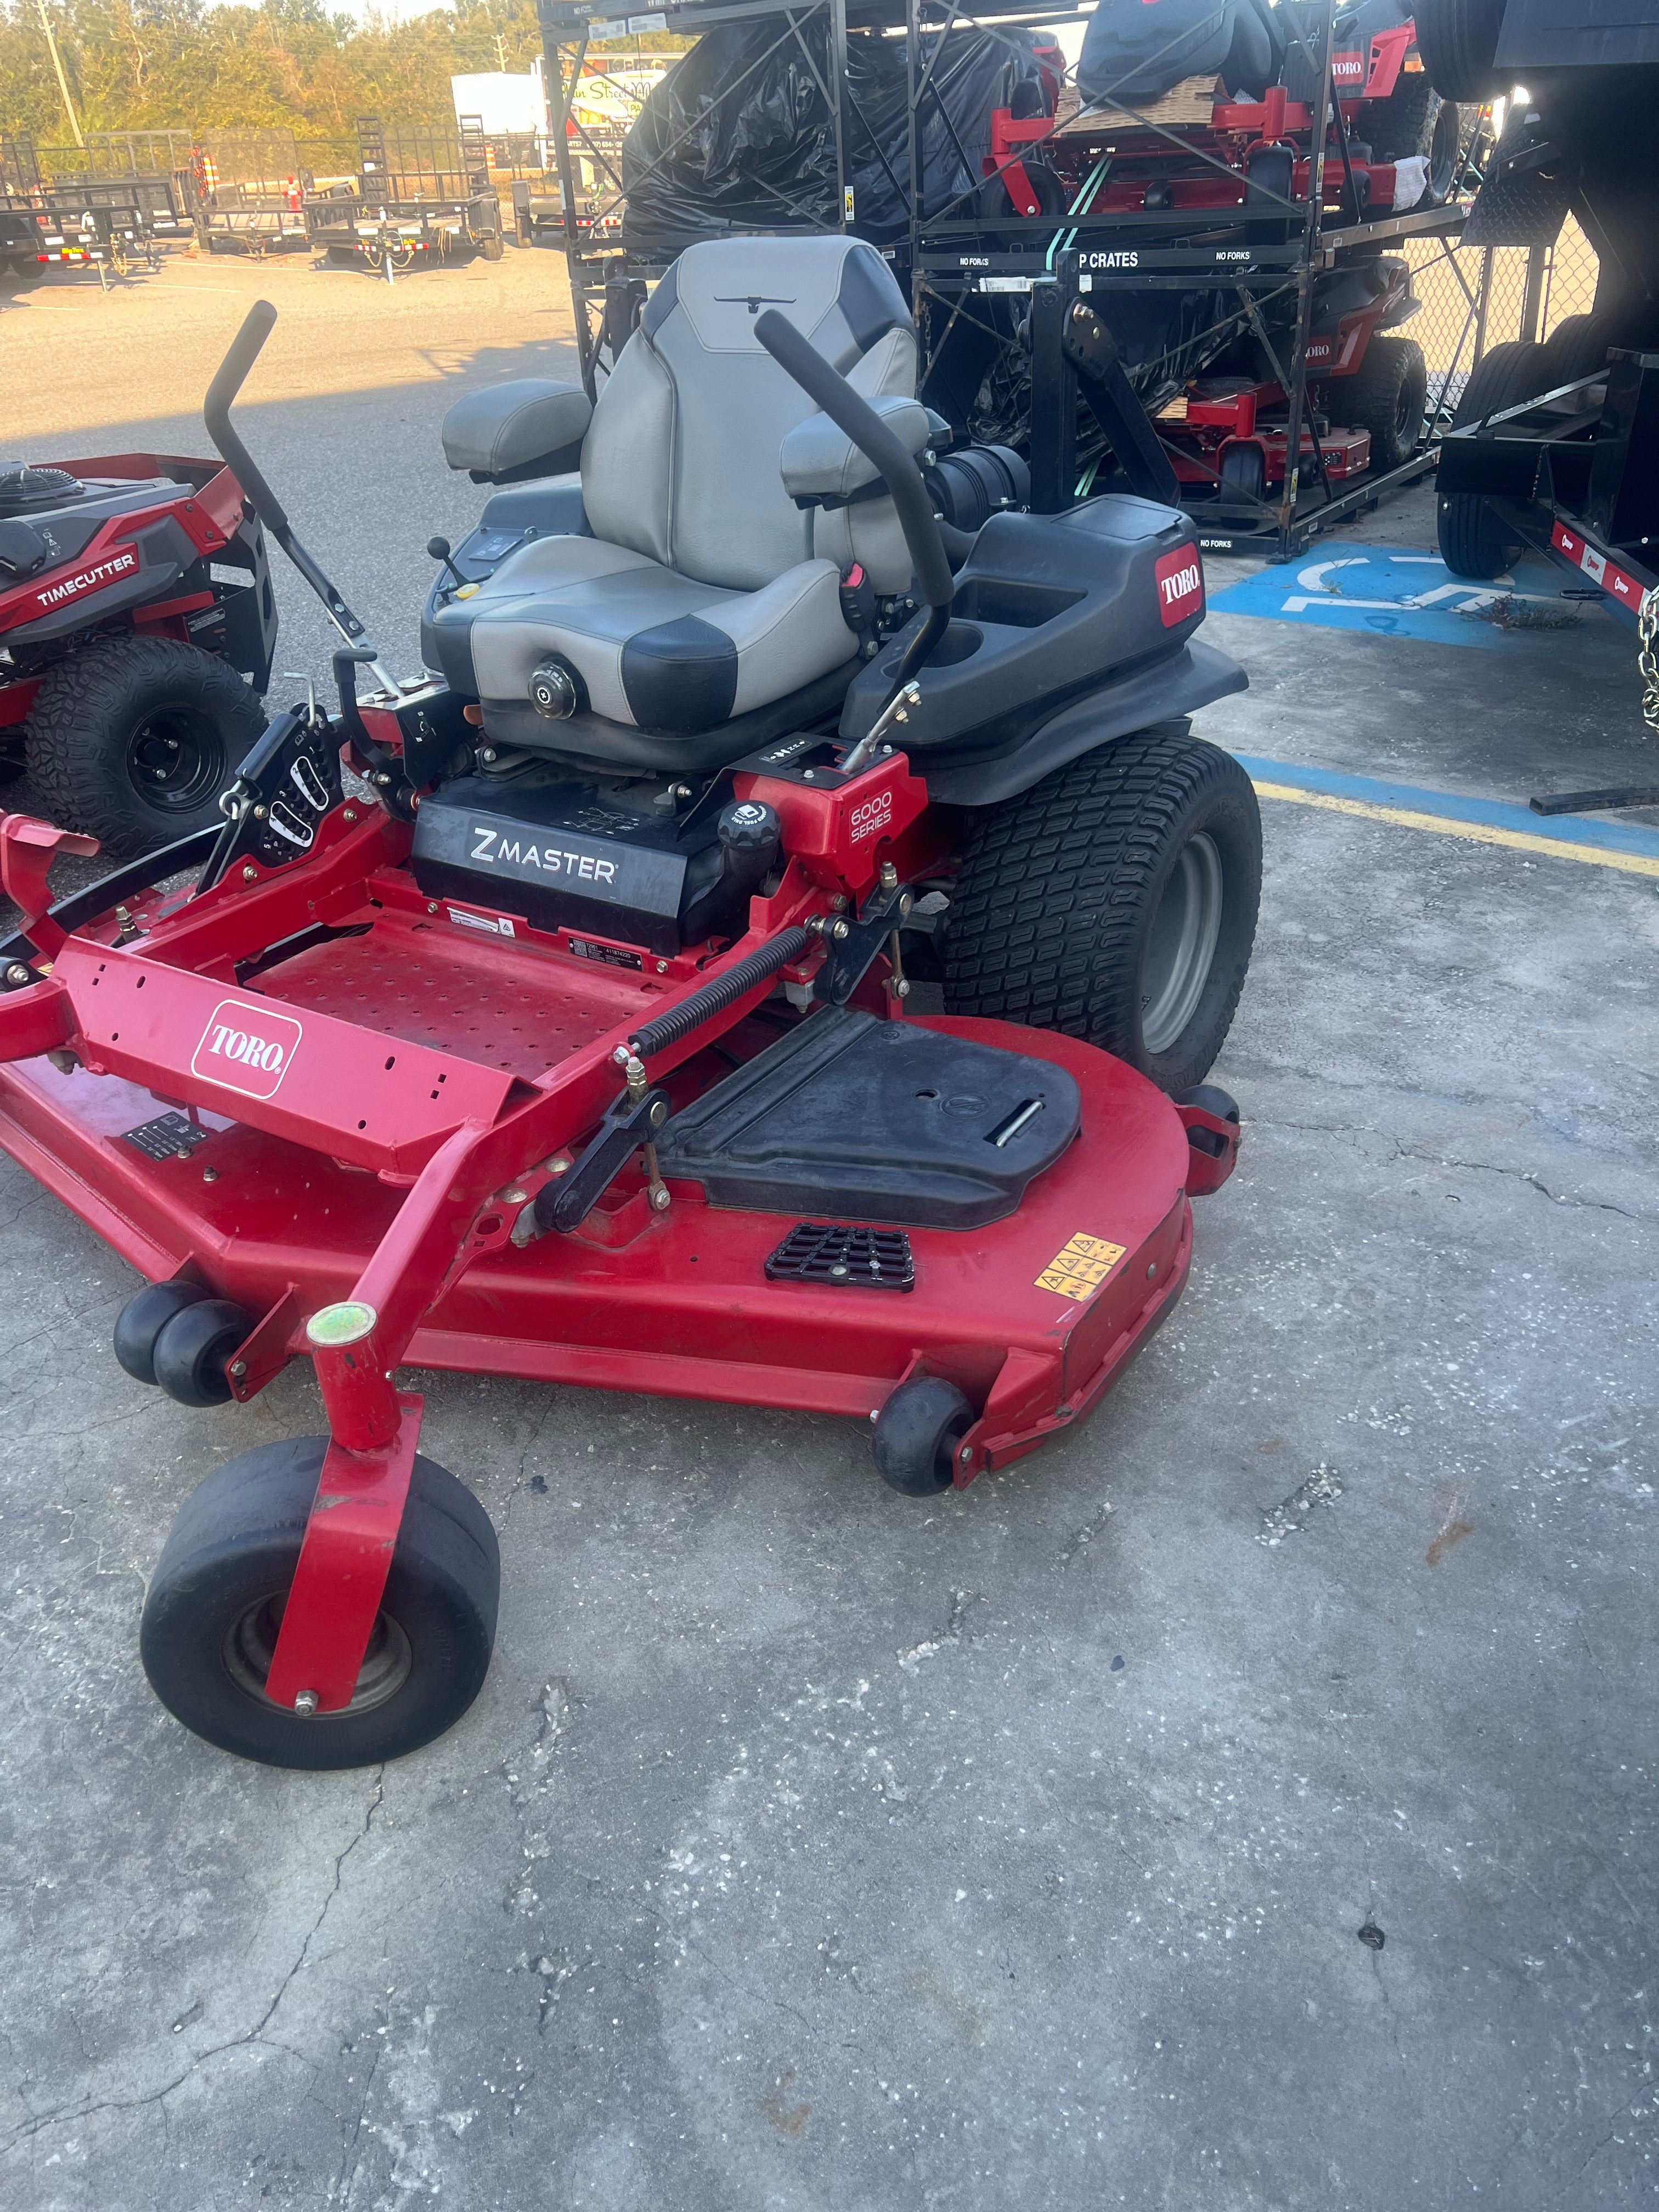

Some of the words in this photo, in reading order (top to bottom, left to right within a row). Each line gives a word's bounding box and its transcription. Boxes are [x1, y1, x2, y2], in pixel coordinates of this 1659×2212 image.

[1331, 61, 1361, 75] TORO
[960, 257, 969, 266] NO
[969, 258, 989, 266] FORKS
[1089, 251, 1138, 268] CRATES
[1216, 252, 1226, 261] NO
[1227, 251, 1250, 260] FORKS
[1307, 344, 1329, 358] ORO
[1210, 540, 1232, 548] FORKS
[37, 554, 135, 606] TIMECUTTER
[1161, 565, 1198, 605] TORO
[851, 792, 891, 826] 6000
[851, 809, 891, 844] SERIES
[471, 827, 498, 862] Z
[498, 839, 615, 884] MASTER
[208, 1024, 284, 1071] TORO
